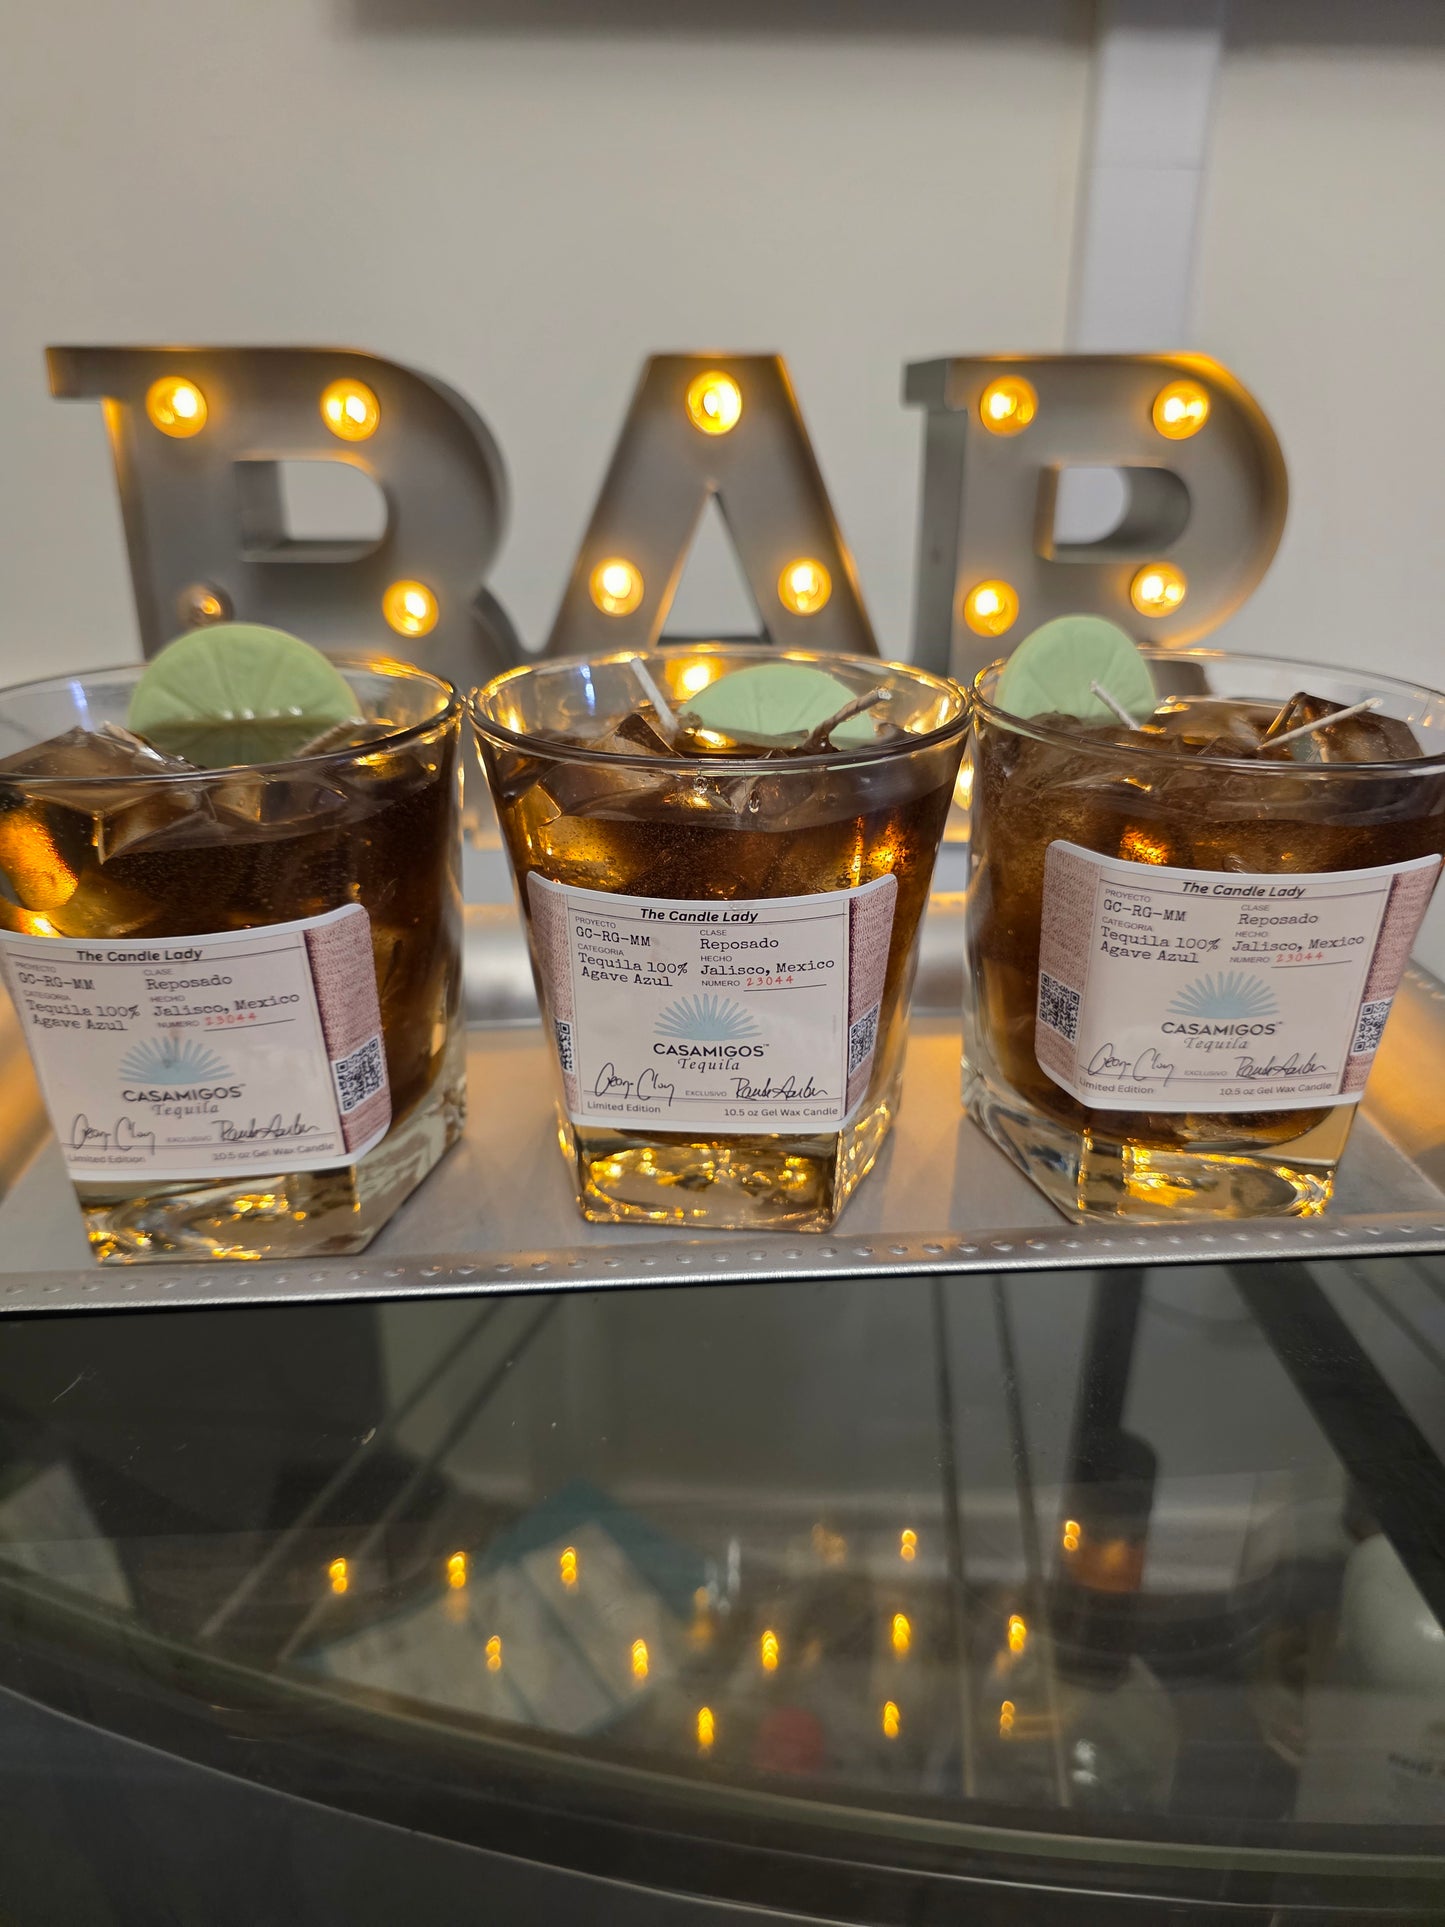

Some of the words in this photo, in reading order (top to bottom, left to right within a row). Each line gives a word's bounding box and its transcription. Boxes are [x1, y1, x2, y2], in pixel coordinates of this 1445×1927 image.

[45, 345, 1289, 682] BAR
[1182, 881, 1208, 894] The
[1212, 884, 1266, 897] Candle
[1268, 886, 1306, 899] Lady
[640, 908, 666, 921] The
[669, 910, 719, 922] Candle
[722, 911, 759, 924] Lady
[1103, 899, 1187, 921] GC-RG-MM
[575, 915, 616, 929] PROYECTO
[1237, 913, 1318, 927] Reposado
[576, 926, 651, 946] GC-RG-MM
[1101, 926, 1170, 946] Tequila
[1175, 938, 1221, 952] 100%
[1232, 941, 1303, 952] Jalisco,
[1308, 936, 1365, 949] Mexico
[577, 943, 624, 956] CATEGORIA
[700, 938, 779, 952] Reposado
[1100, 940, 1151, 958] Agave
[1157, 950, 1199, 963] Azul
[77, 950, 103, 961] The
[107, 951, 160, 962] Candle
[164, 948, 203, 961] Lady
[578, 952, 642, 971] Tequila
[647, 961, 688, 976] 100%
[700, 965, 770, 976] Jalisco,
[776, 960, 835, 973] Mexico
[18, 972, 96, 990] GC-RG-MM
[145, 975, 232, 992] Reposado
[581, 966, 629, 982] Agave
[633, 974, 673, 987] Azul
[746, 975, 794, 987] 23044
[25, 999, 93, 1016] Tequila
[96, 1005, 141, 1019] 100%
[153, 1004, 230, 1017] Jalisco,
[234, 993, 300, 1011] Mexico
[32, 1014, 81, 1029] Agave
[86, 1018, 129, 1031] Azul
[1184, 1037, 1248, 1052] Tequila
[677, 1058, 740, 1073] Tequila
[151, 1101, 220, 1119] Tequila
[587, 1101, 624, 1111] Limited
[626, 1104, 661, 1113] Edition
[724, 1108, 745, 1116] 10.5
[761, 1108, 778, 1117] Gel
[803, 1107, 838, 1116] Candle
